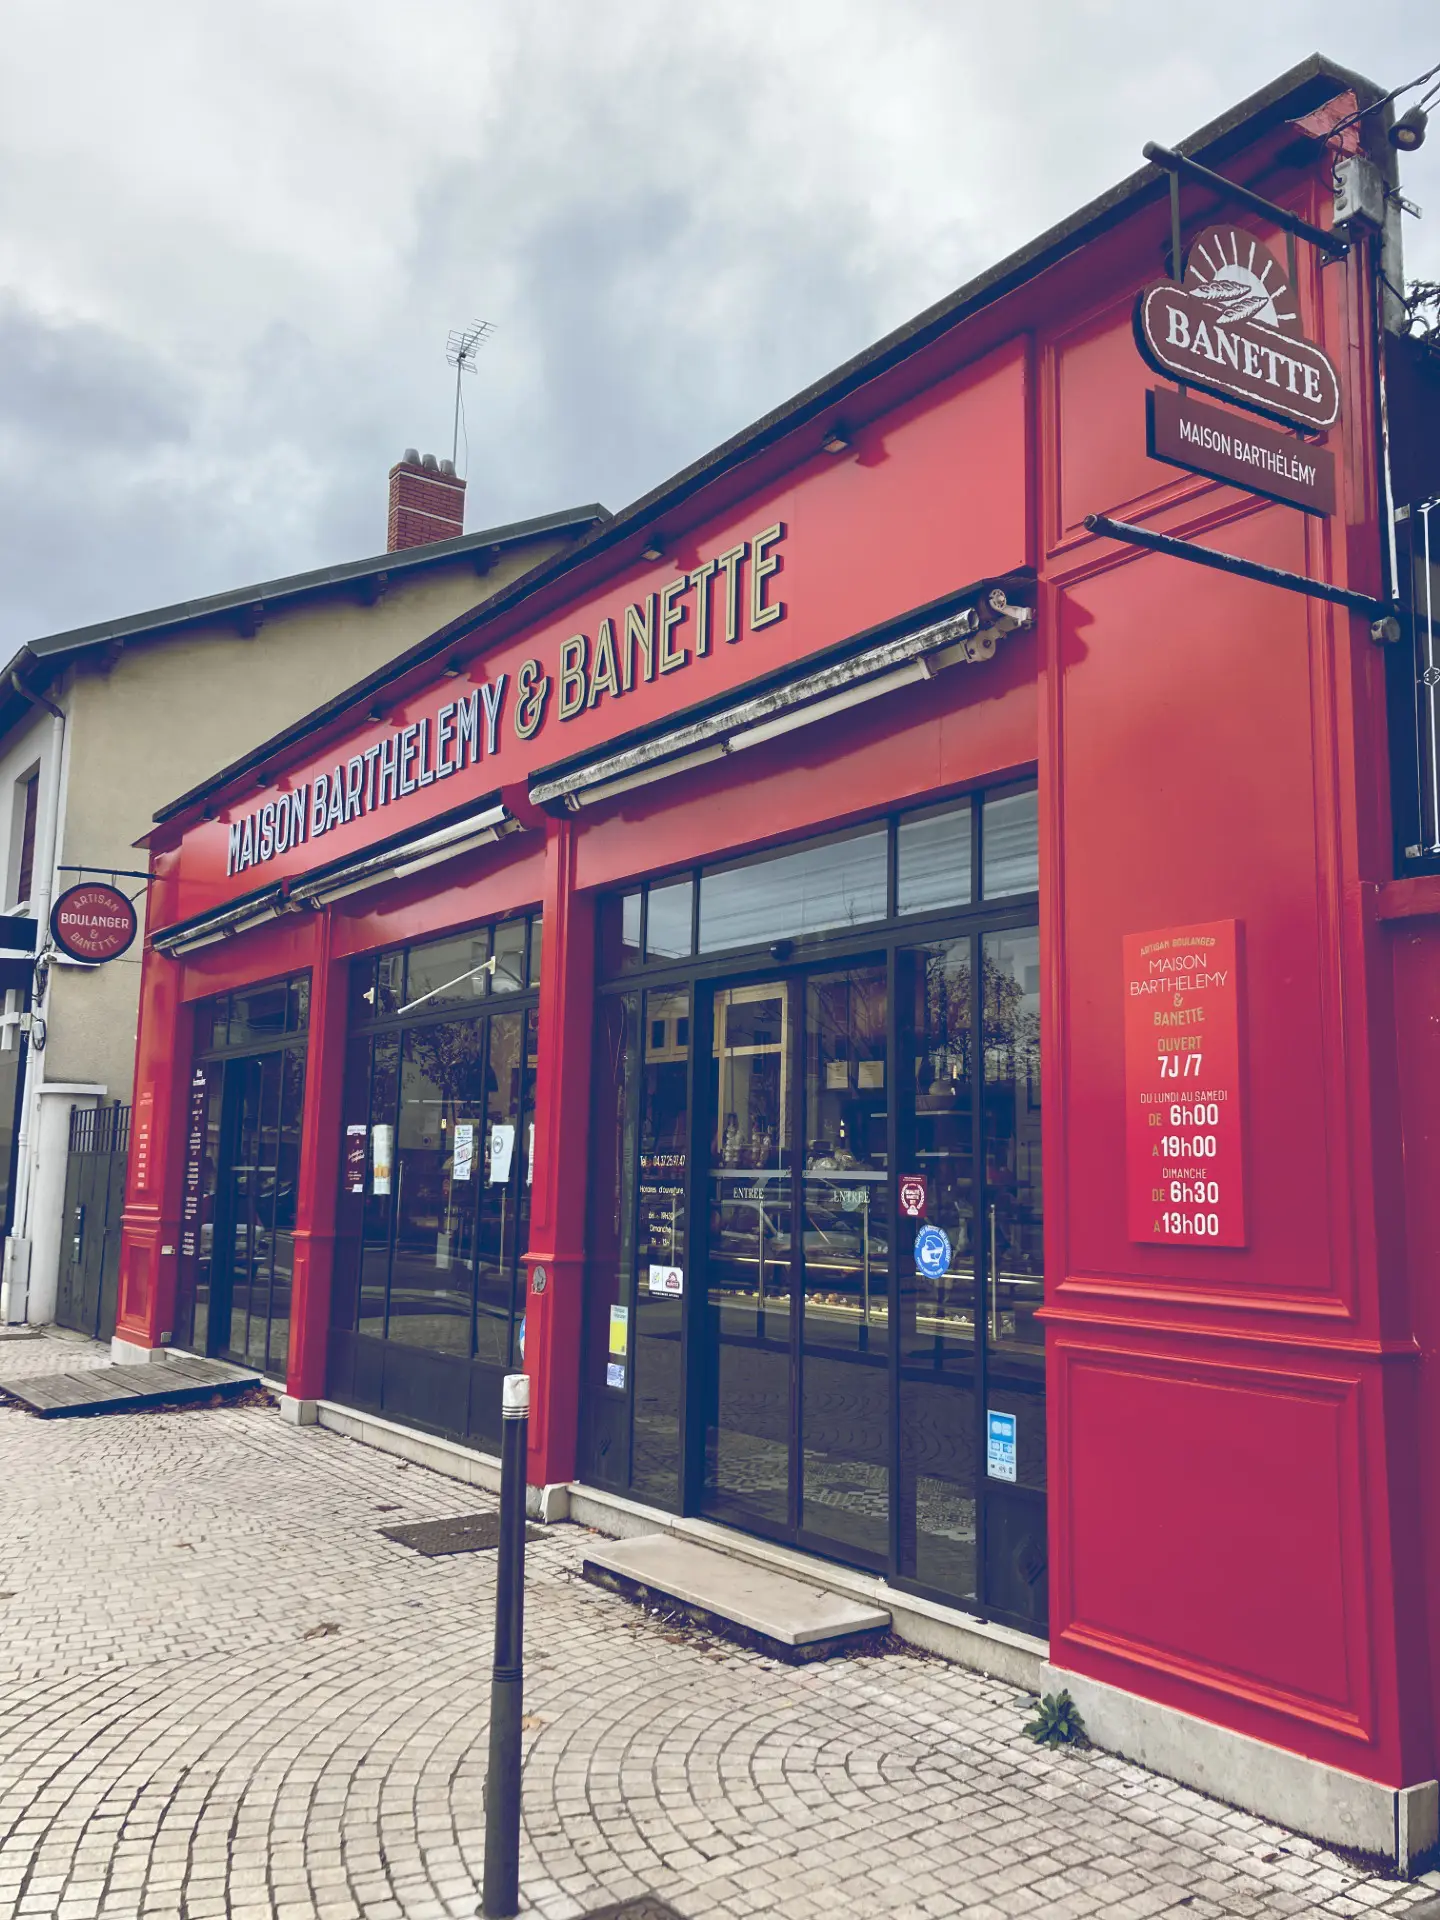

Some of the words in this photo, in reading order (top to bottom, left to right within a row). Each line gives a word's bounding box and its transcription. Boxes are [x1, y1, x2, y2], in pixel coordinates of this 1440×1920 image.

[1165, 304, 1323, 404] BANETTE
[1179, 418, 1232, 456] MAISON
[1233, 438, 1317, 486] BARTHÉLÉMY
[225, 783, 306, 876] MAISON
[311, 673, 508, 838] BARTHELEMY
[513, 658, 550, 740] &
[557, 522, 788, 722] BANETTE
[73, 893, 119, 912] ARTISAN
[61, 912, 129, 929] BOULANGER
[70, 932, 119, 951] BANETTE
[89, 929, 99, 939] &
[1140, 940, 1170, 957] ARTISAN
[1172, 937, 1216, 948] BOULANGER
[1149, 953, 1207, 974] MAISON
[1130, 970, 1228, 996] BARTHELEMY
[1173, 992, 1183, 1007] &
[1153, 1007, 1205, 1026] BANETTE
[1157, 1035, 1202, 1052] OUVERT
[1140, 1093, 1152, 1104] DU
[1154, 1092, 1179, 1103] LUNDI
[1181, 1091, 1192, 1102] AU
[1194, 1090, 1228, 1102] SAMEDI
[1148, 1113, 1162, 1126] DE
[1170, 1104, 1219, 1126] 6h00
[1161, 1135, 1217, 1157] 19h00
[1162, 1168, 1207, 1179] DIMANCHE
[1152, 1188, 1165, 1202] DE
[1170, 1180, 1219, 1204] 6h30
[1162, 1212, 1219, 1236] 13h00
